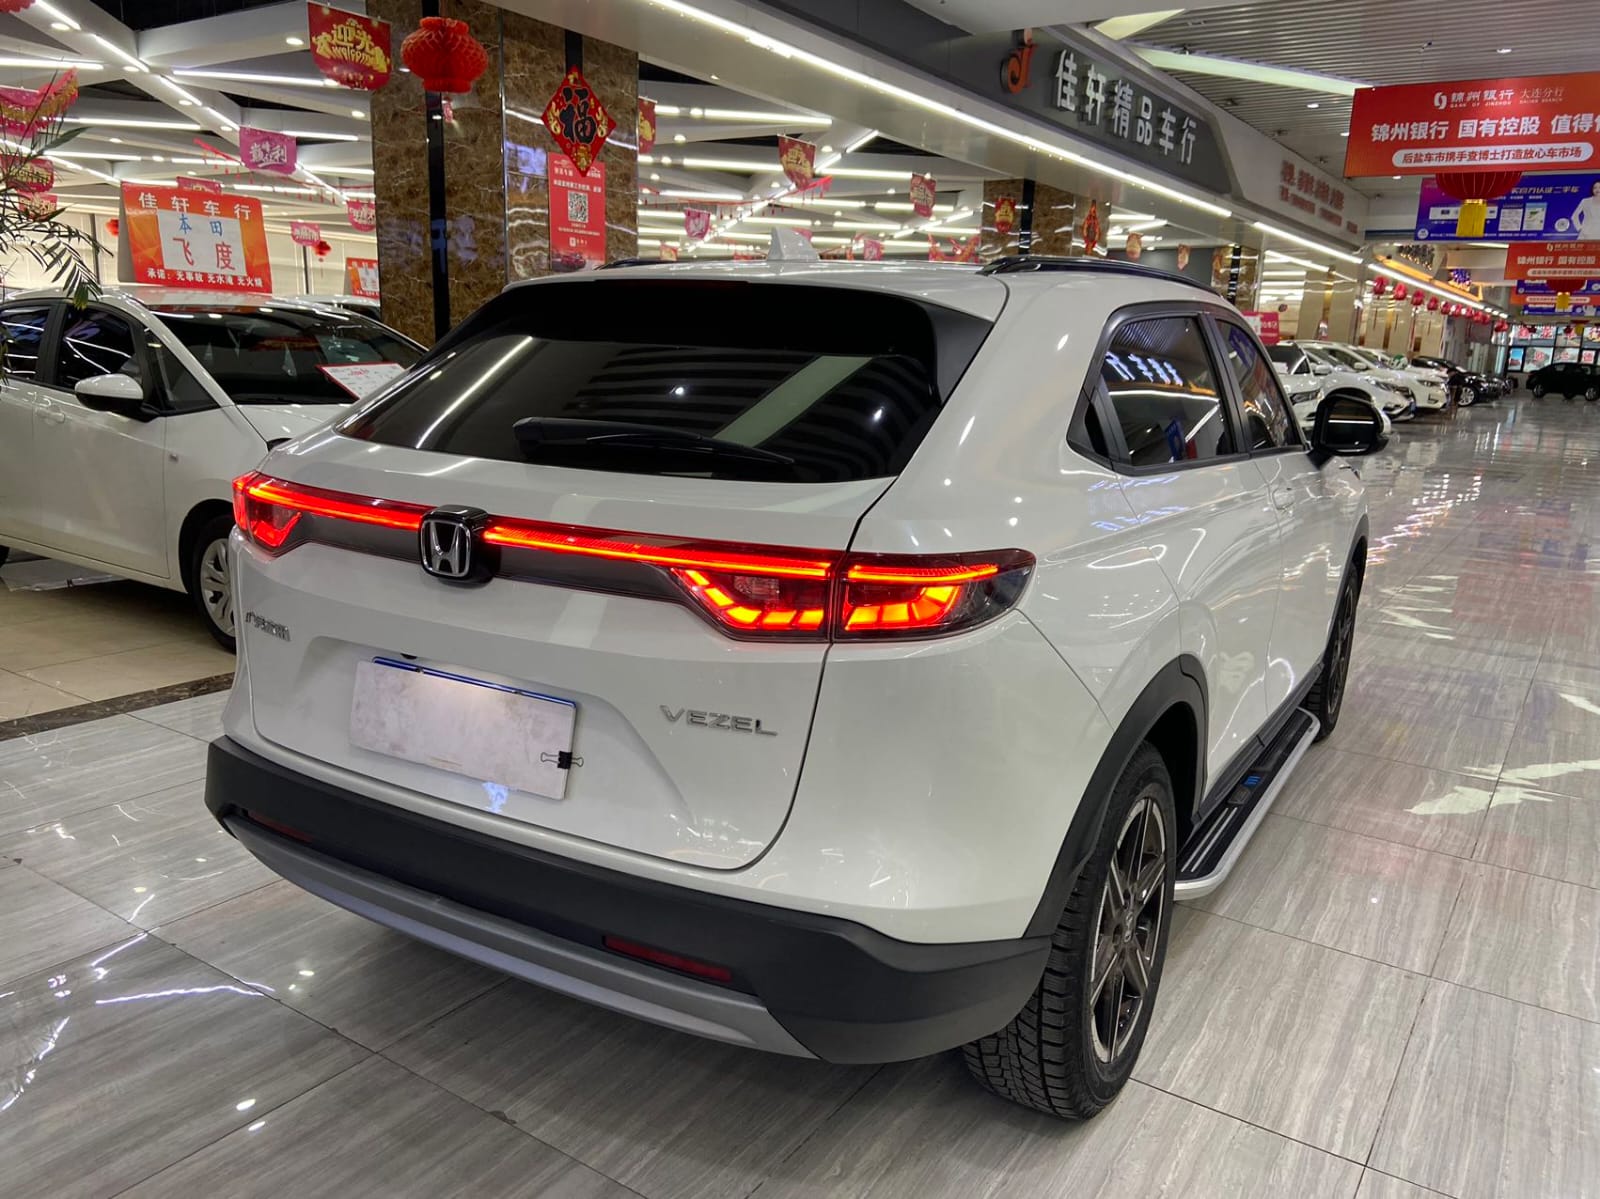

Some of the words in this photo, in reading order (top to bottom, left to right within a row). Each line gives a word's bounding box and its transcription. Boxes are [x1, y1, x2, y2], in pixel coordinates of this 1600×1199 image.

[1056, 50, 1197, 165] 佳轩精品车行
[1451, 89, 1515, 103] 锦州银行
[1521, 87, 1565, 99] 大连分行
[559, 86, 597, 144] 福
[1371, 121, 1450, 142] 锦州银行
[1457, 115, 1541, 138] 国有控股
[1402, 147, 1582, 164] 后盐车市携手查博士打造放心车市场
[138, 192, 251, 220] 佳轩车行
[179, 214, 223, 236] 本田
[173, 237, 236, 271] 飞度
[660, 704, 778, 736] VEZEL
